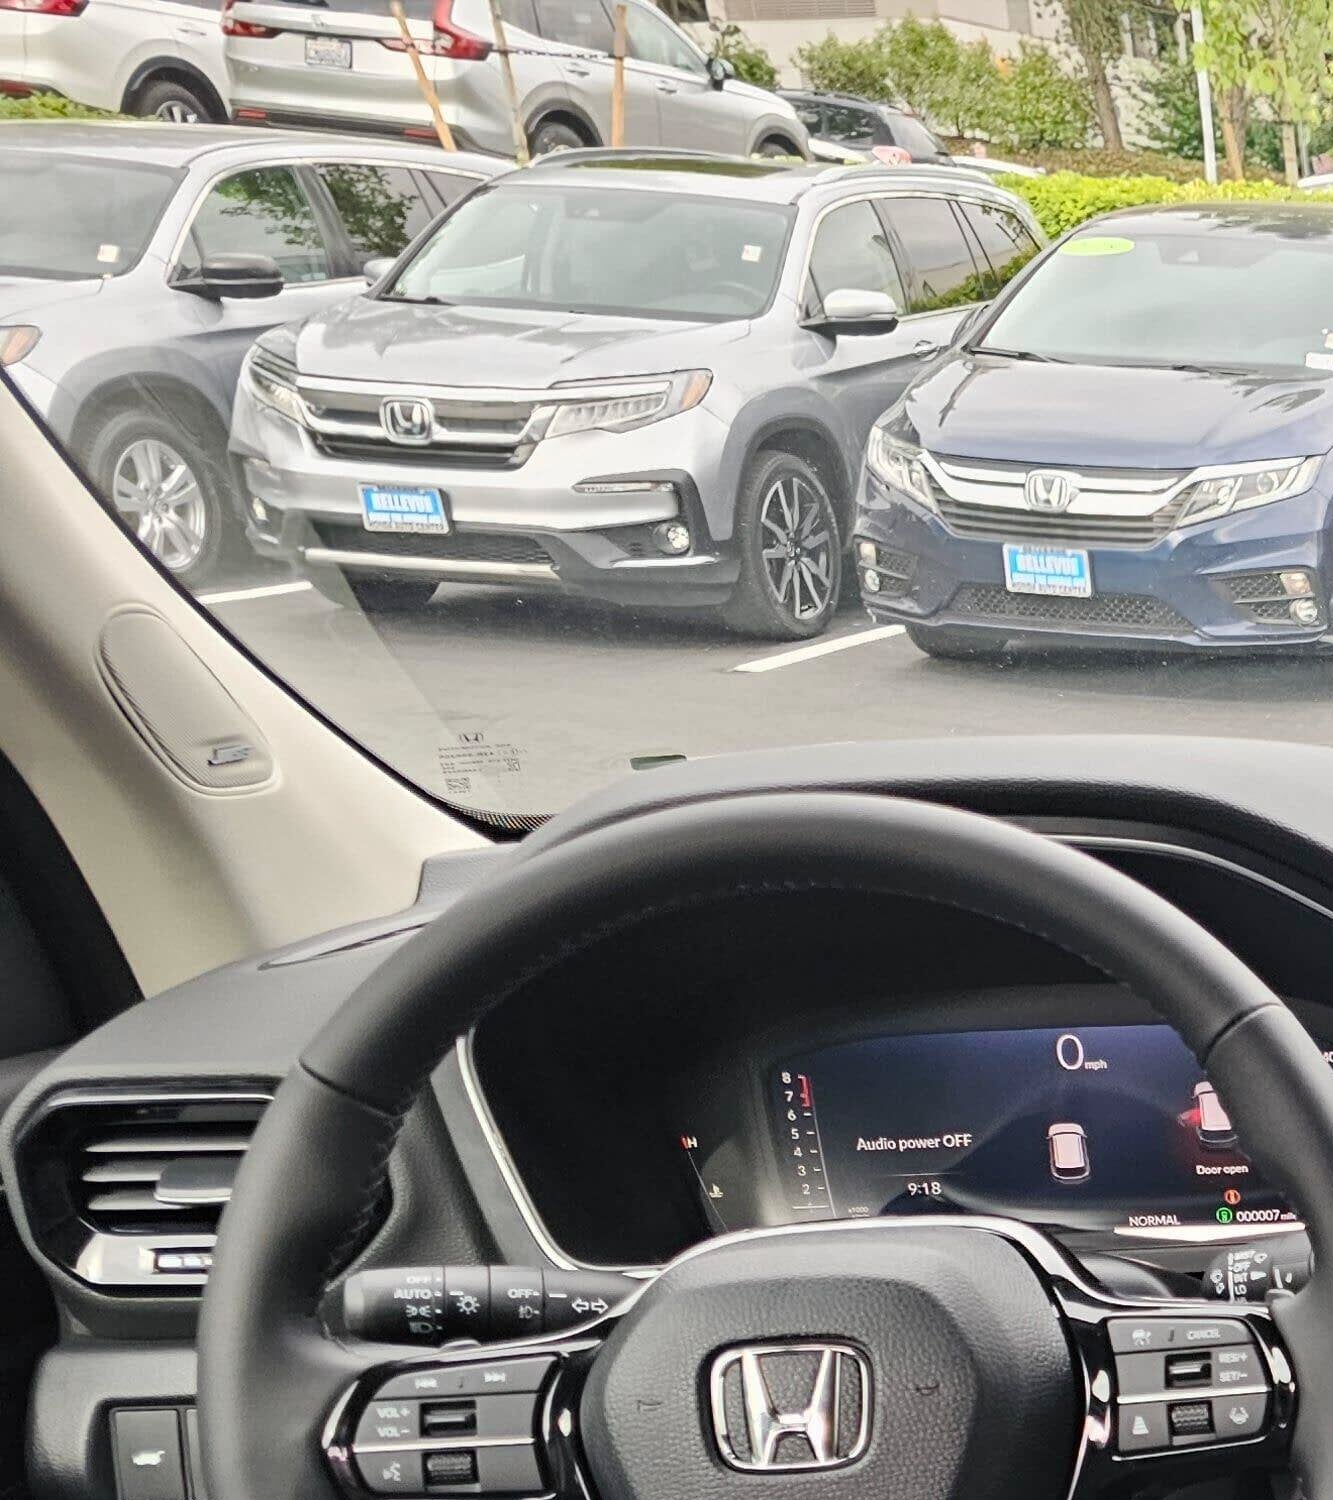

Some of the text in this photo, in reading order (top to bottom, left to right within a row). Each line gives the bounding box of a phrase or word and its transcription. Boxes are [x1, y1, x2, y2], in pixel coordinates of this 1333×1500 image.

[1056, 1034, 1108, 1071] 0 mph
[781, 1072, 791, 1084] 8
[784, 1091, 793, 1102] 7
[787, 1109, 796, 1121] 6
[791, 1128, 799, 1140] 5
[857, 1133, 972, 1152] Audio power OFF
[794, 1147, 803, 1157] 4
[797, 1165, 806, 1176] 3
[1196, 1165, 1249, 1175] Door open
[802, 1184, 810, 1195] 2
[908, 1181, 942, 1196] 9:18
[1129, 1215, 1181, 1226] NORMAL
[1236, 1209, 1280, 1222] 000007
[394, 1289, 533, 1300] AUTO OFF
